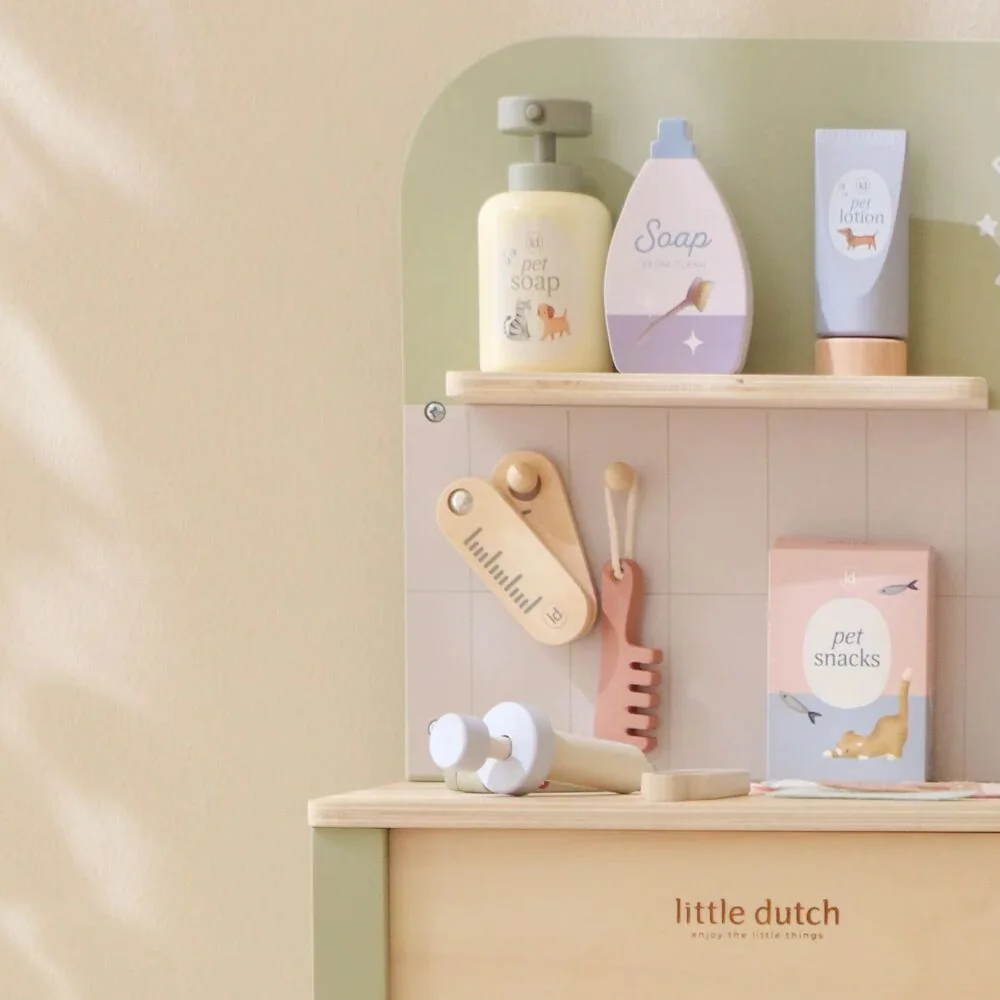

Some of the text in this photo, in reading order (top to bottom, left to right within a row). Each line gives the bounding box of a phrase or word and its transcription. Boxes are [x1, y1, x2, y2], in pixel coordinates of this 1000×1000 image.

[850, 198, 871, 213] pet
[840, 208, 884, 224] lotion
[634, 218, 713, 257] Soap
[521, 257, 547, 276] pet
[511, 275, 560, 297] soap
[831, 628, 864, 649] pet
[814, 648, 880, 668] snacks
[676, 897, 840, 926] little dutch
[691, 931, 824, 941] enjoy the little things
